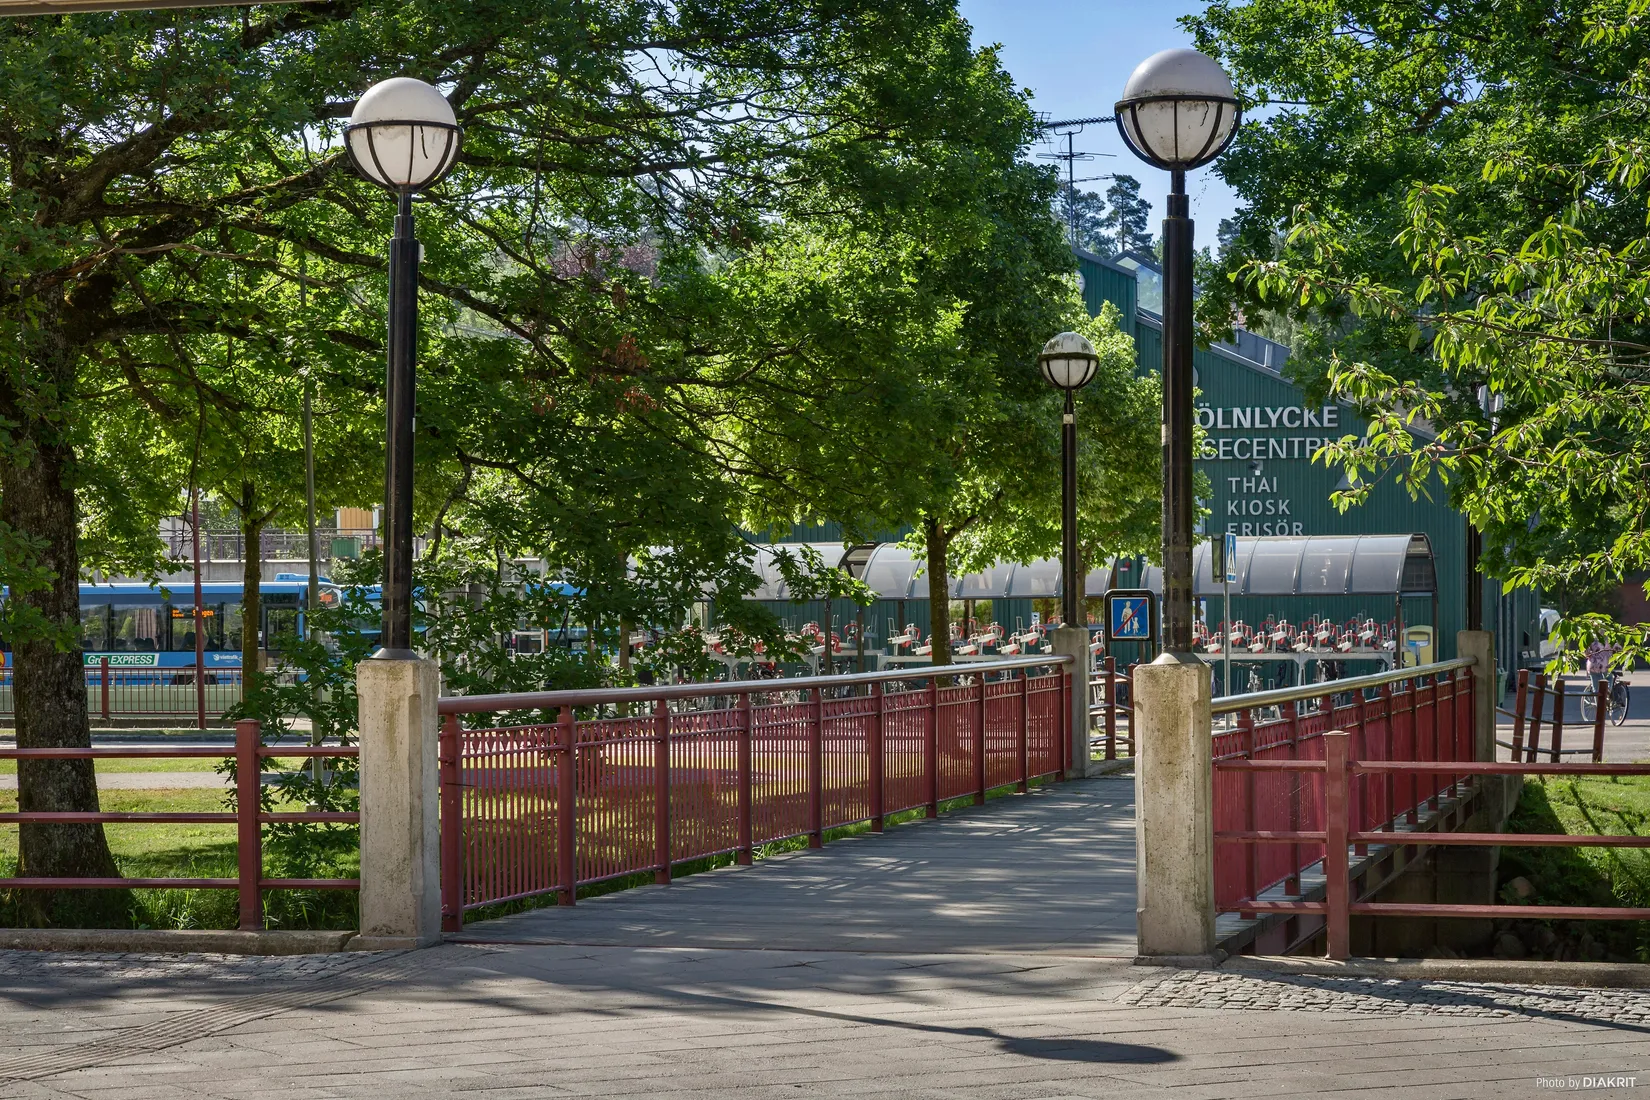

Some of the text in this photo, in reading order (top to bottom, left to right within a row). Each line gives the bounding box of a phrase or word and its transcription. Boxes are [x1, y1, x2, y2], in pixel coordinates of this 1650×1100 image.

[1194, 403, 1339, 429] ÖLNLYCKE
[1227, 476, 1278, 493] THAI
[1227, 499, 1291, 516] KIOSK
[1227, 519, 1303, 536] FRISÖR
[110, 655, 153, 665] EXPRESS
